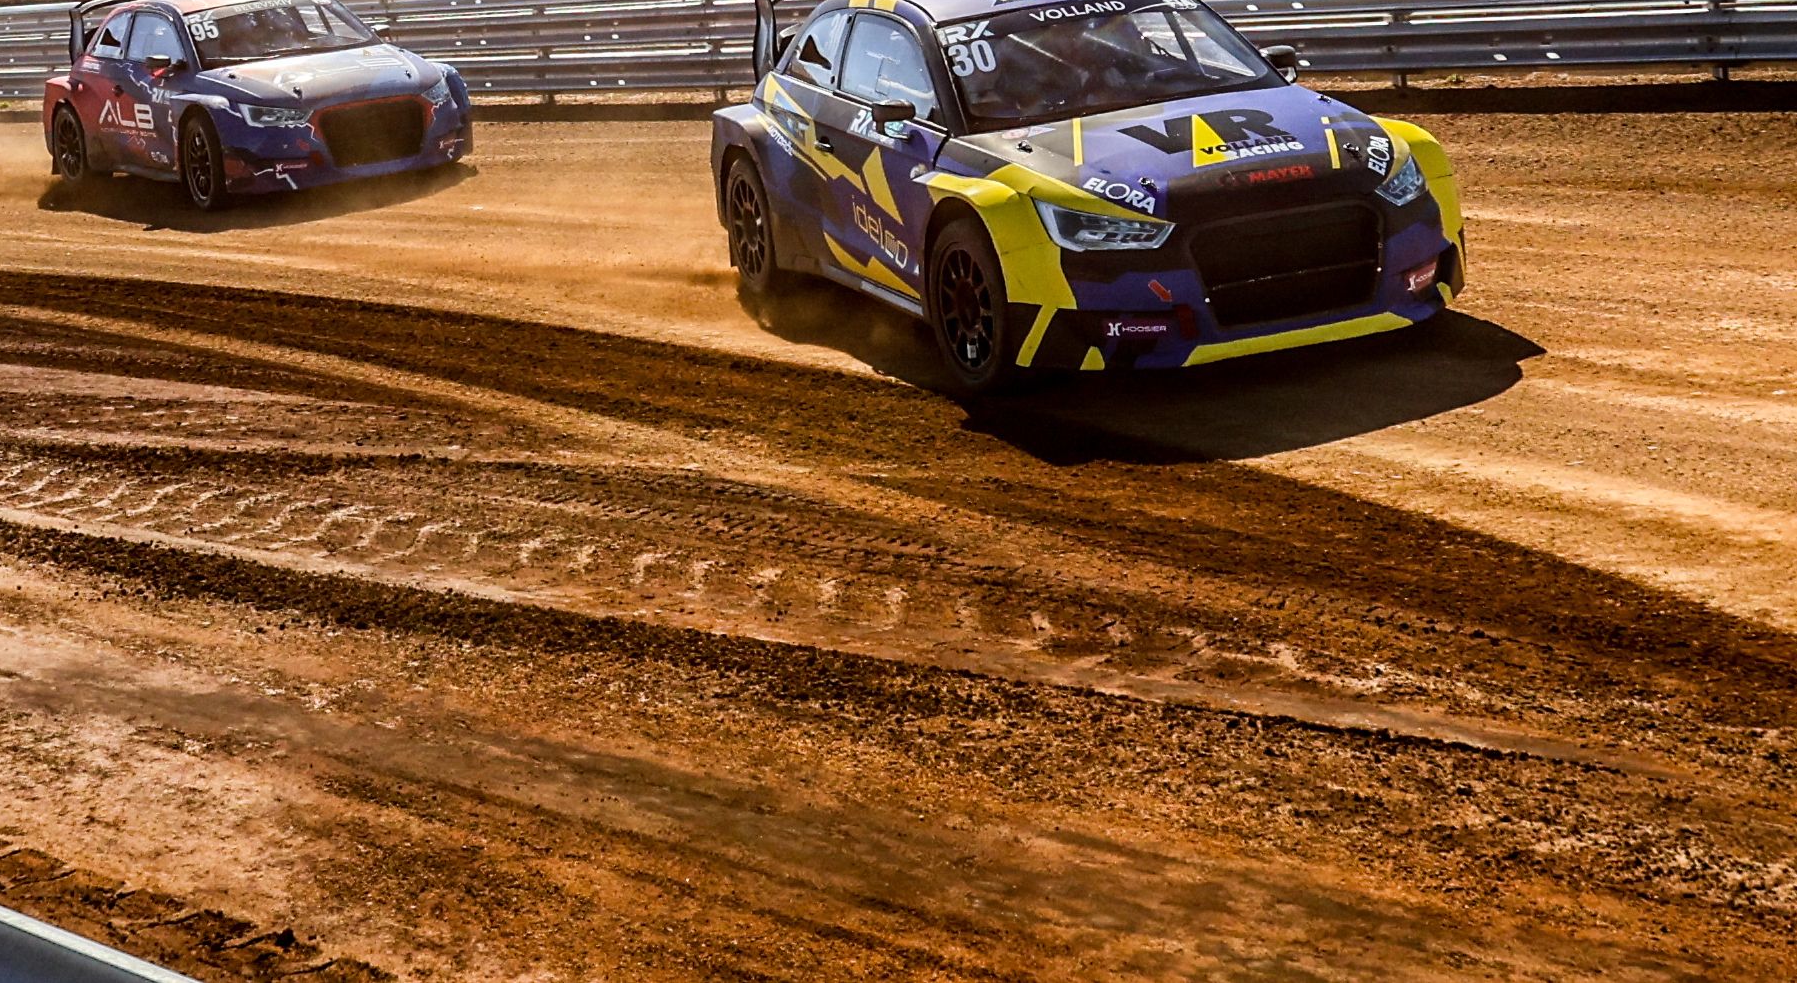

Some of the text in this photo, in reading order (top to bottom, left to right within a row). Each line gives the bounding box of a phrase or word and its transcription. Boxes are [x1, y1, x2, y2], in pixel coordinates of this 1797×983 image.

[1029, 0, 1126, 22] VOLLAND
[191, 20, 219, 41] 95
[944, 20, 995, 44] RX
[948, 39, 997, 77] 30
[99, 99, 154, 130] ALB
[1116, 109, 1292, 155] VR
[1200, 135, 1297, 155] VOLLAND
[1225, 141, 1305, 161] RACING
[1367, 135, 1391, 176] ELORA
[1248, 163, 1315, 183] MAYER
[1083, 177, 1156, 215] ELORA
